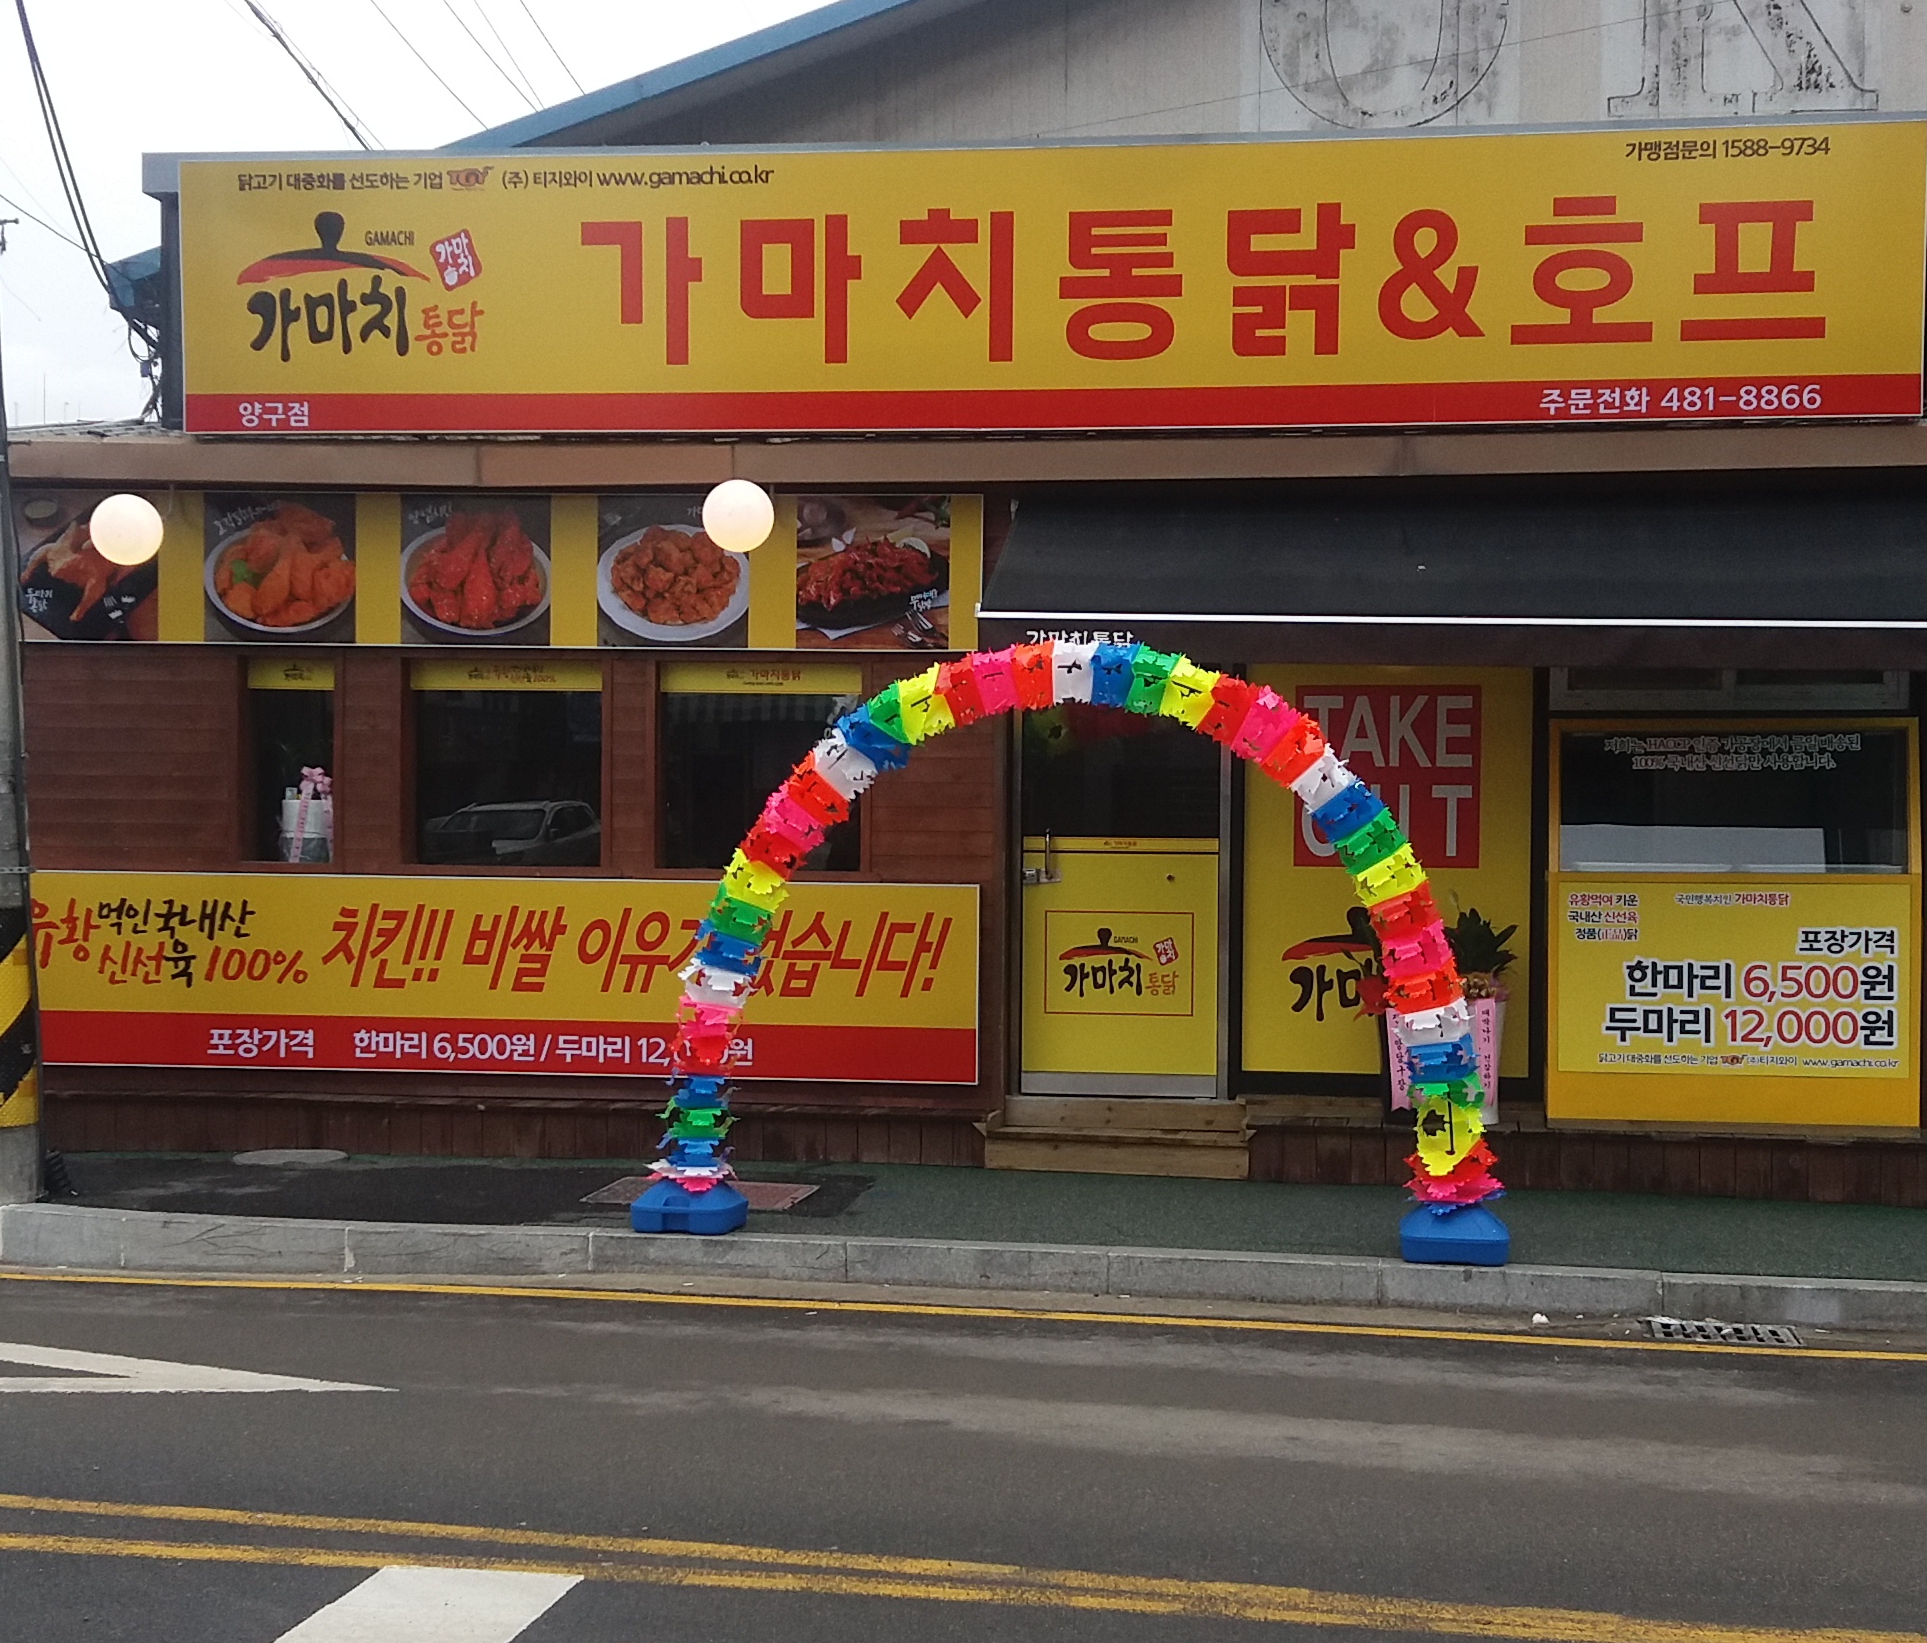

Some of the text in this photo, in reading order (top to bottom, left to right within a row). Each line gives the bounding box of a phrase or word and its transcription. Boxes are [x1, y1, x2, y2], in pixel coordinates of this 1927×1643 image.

[1625, 136, 1831, 162] 가맹점문의 1588-9734
[238, 173, 283, 191] 닭고기
[286, 173, 346, 190] 대중화를
[349, 172, 410, 190] 선도하는
[413, 171, 443, 189] 기업
[501, 170, 528, 189] (주)
[532, 170, 593, 188] 티지와이
[596, 164, 775, 189] www.gamachi.co.kr
[364, 230, 415, 247] GAMACHI
[246, 274, 485, 363] 가마치 통닭
[238, 400, 310, 428] 양구점
[1539, 384, 1822, 416] 주문전화 481-8866
[1302, 695, 1473, 768] TAKE
[1615, 893, 1638, 906] 키운
[1734, 893, 1790, 905] 가마치통닭
[1568, 911, 1638, 924] 국내산 신선육
[31, 898, 256, 970] 유황 먹인 국내산
[321, 902, 456, 990] 치킨!!
[462, 904, 566, 993] 비쌀
[1799, 929, 1895, 955] 포장가격
[97, 938, 308, 988] 신선육 100%
[1063, 957, 1180, 998] 가마치 통닭
[1625, 959, 1895, 1003] 한마리 6,500원
[1605, 1007, 1895, 1047] 두마리 12,000원
[206, 1028, 315, 1059] 포장가격
[353, 1029, 427, 1060] 한마리
[433, 1032, 535, 1062] 6,500원
[555, 1033, 631, 1064] 두마리
[637, 1036, 754, 1067] 12,원
[1598, 1053, 1625, 1063] 닭고기
[1701, 1055, 1718, 1065] 기업
[1801, 1058, 1899, 1068] www.gamachi.co.kr
